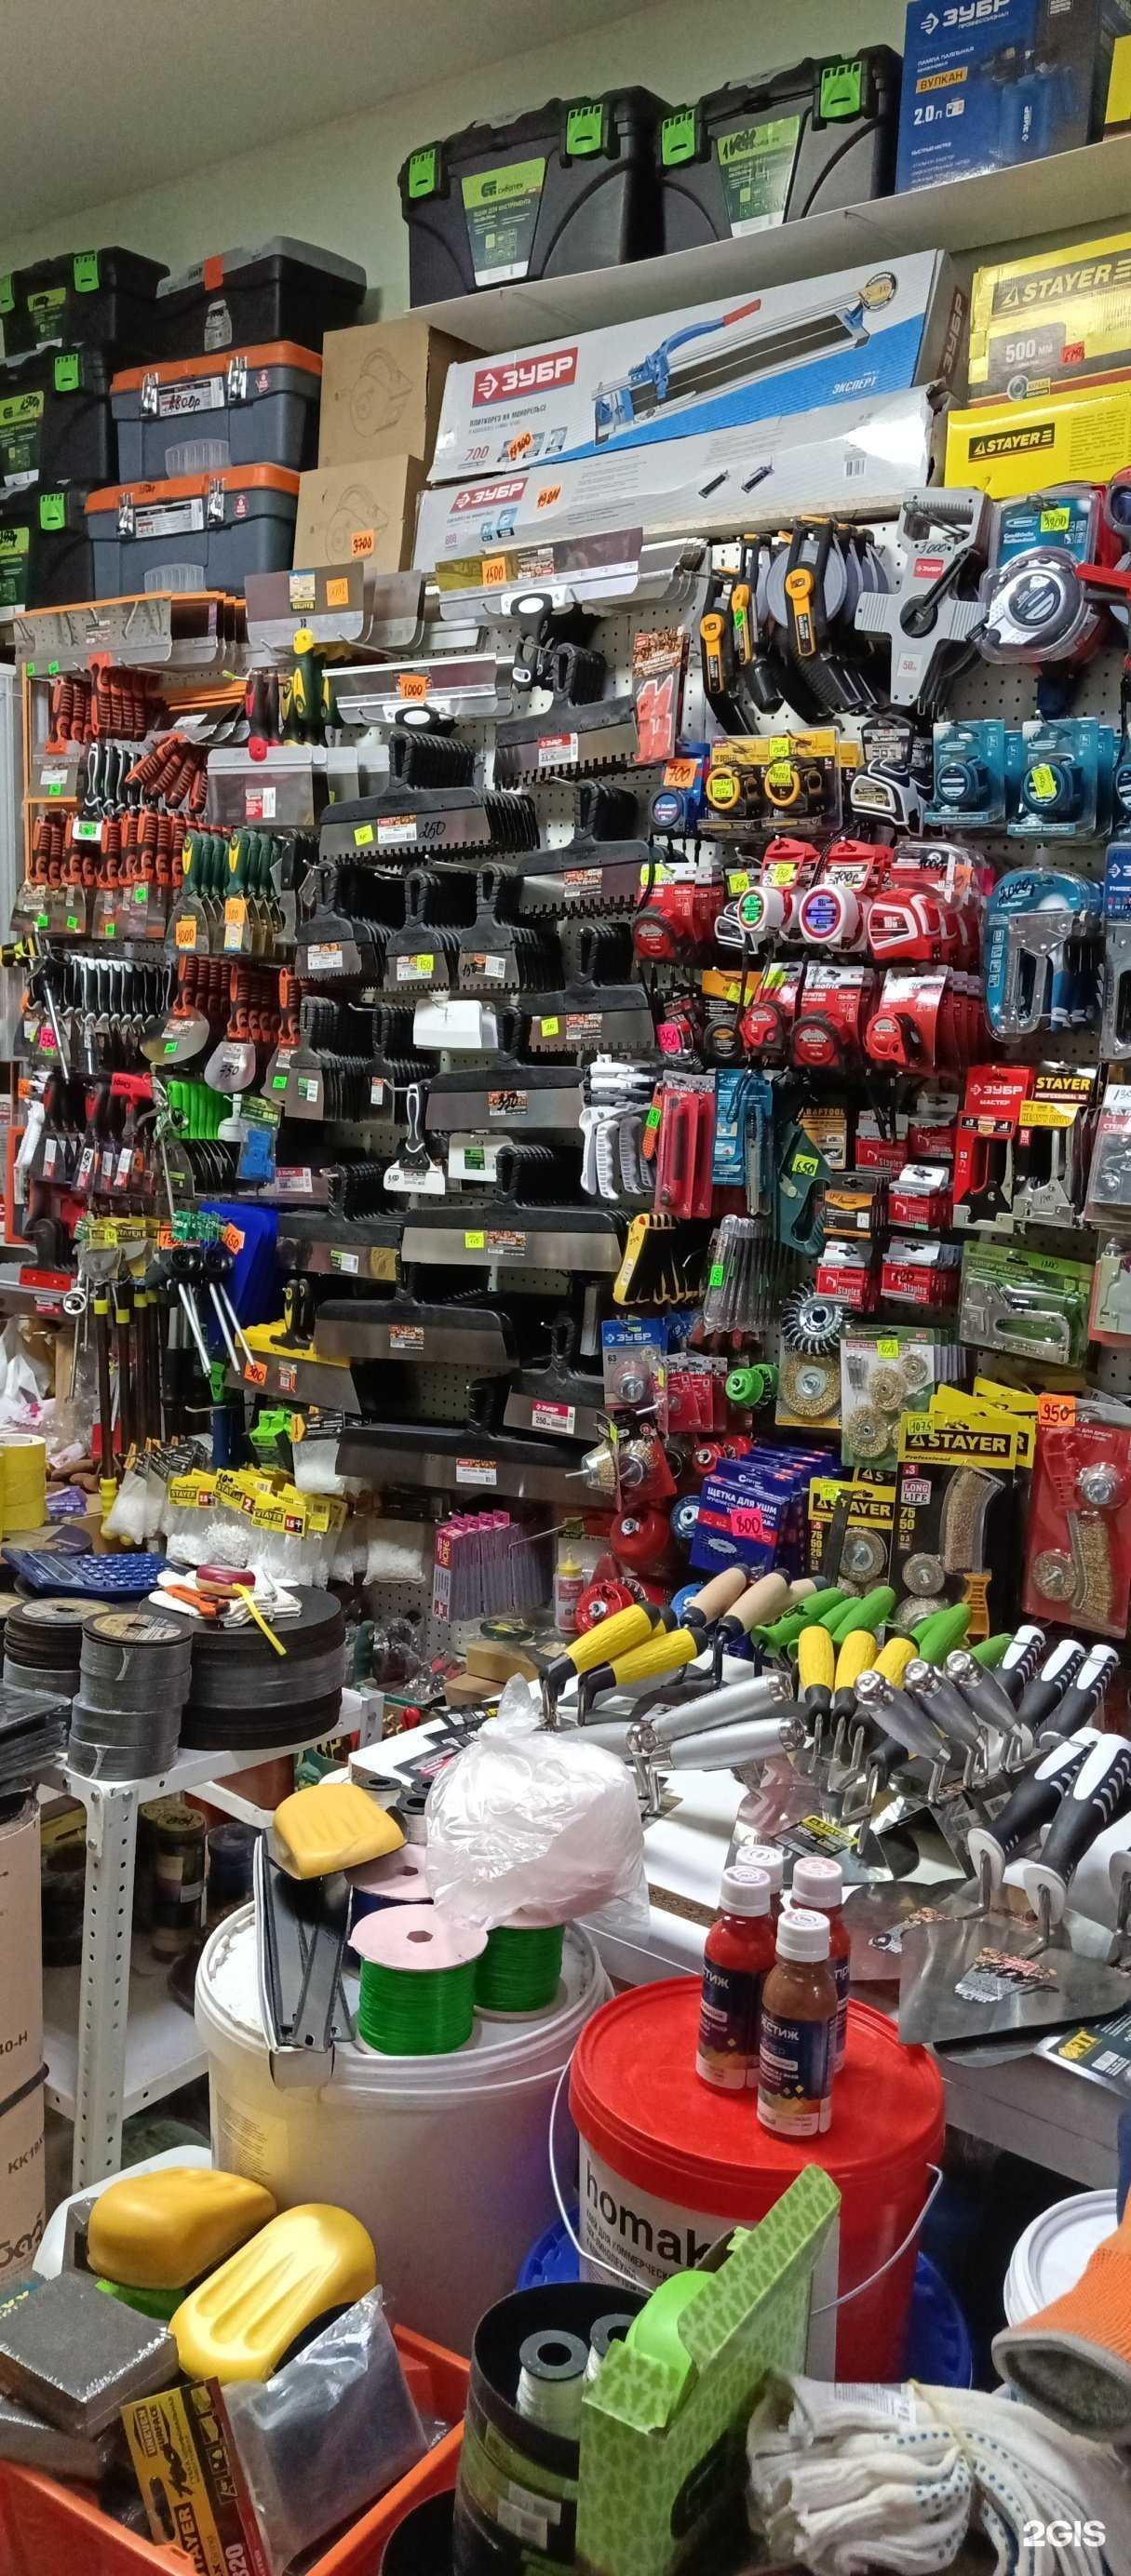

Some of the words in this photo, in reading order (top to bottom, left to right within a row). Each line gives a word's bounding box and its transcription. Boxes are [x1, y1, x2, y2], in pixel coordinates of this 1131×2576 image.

[942, 0, 1010, 26] ЗУБР
[920, 71, 964, 91] ВУЛКАН
[913, 105, 935, 126] 2.0
[1022, 263, 1112, 302] STAYER
[942, 292, 964, 374] ЗУБР
[1005, 339, 1036, 363] 500
[502, 356, 574, 392] ЗУБР
[832, 375, 879, 395] ЭКСПЕРТ
[986, 432, 1042, 453] STAYER
[465, 446, 490, 463] 700
[471, 481, 525, 504] ЗУБР
[352, 536, 373, 554] 3700
[486, 564, 504, 582] 1500
[403, 684, 423, 698] 1000
[178, 928, 195, 944] 1000
[983, 1085, 1023, 1095] ЗУБР
[1036, 1076, 1091, 1091] STAYER
[794, 1161, 815, 1174] 650
[879, 1157, 903, 1168] Staples
[837, 1286, 861, 1296] Staples
[903, 1282, 927, 1295] Staples
[616, 1333, 652, 1342] ЗУБР
[607, 1354, 617, 1362] 63
[1041, 1402, 1070, 1423] 950
[927, 1432, 1006, 1453] STAYER
[171, 1489, 196, 1498] STAYER
[904, 1483, 929, 1493] LONG
[707, 1486, 736, 1503] ЩЕТКА
[736, 1496, 755, 1509] ДЛЯ
[756, 1502, 777, 1515] УШМ
[904, 1493, 928, 1502] LIFE
[900, 1506, 916, 1518] 75
[736, 1515, 761, 1534] 800
[899, 1518, 915, 1531] 50
[811, 1530, 823, 1539] 75
[810, 1540, 823, 1549] 50
[703, 1964, 730, 1990] СТИЖ
[761, 2012, 800, 2041] ЕСТИЖ
[586, 2157, 711, 2269] homak
[136, 2406, 157, 2458] UNEVEN
[176, 2503, 209, 2576] TAYER
